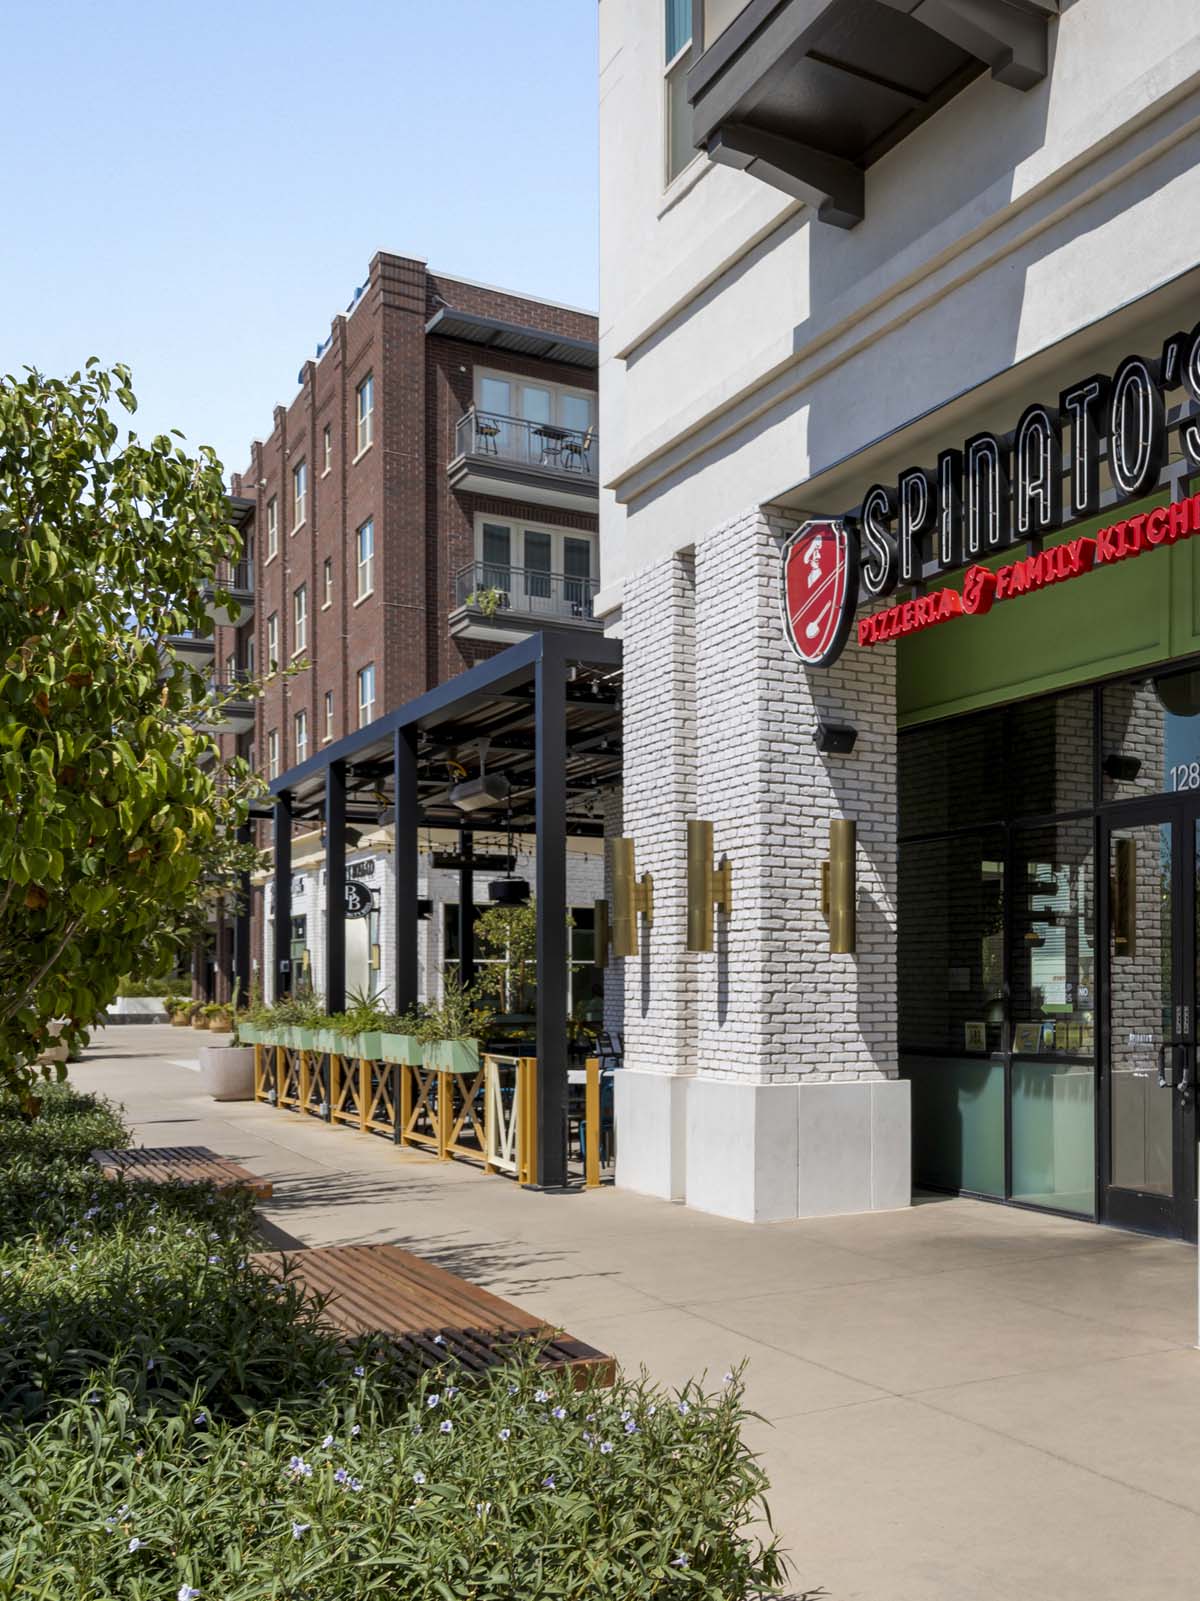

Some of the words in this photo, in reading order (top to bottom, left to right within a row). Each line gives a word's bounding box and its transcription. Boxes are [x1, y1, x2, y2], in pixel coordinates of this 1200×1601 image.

[857, 587, 963, 647] PIZZERIA
[961, 564, 997, 615] &
[995, 536, 1097, 600] FAMILY
[1169, 762, 1200, 792] 128
